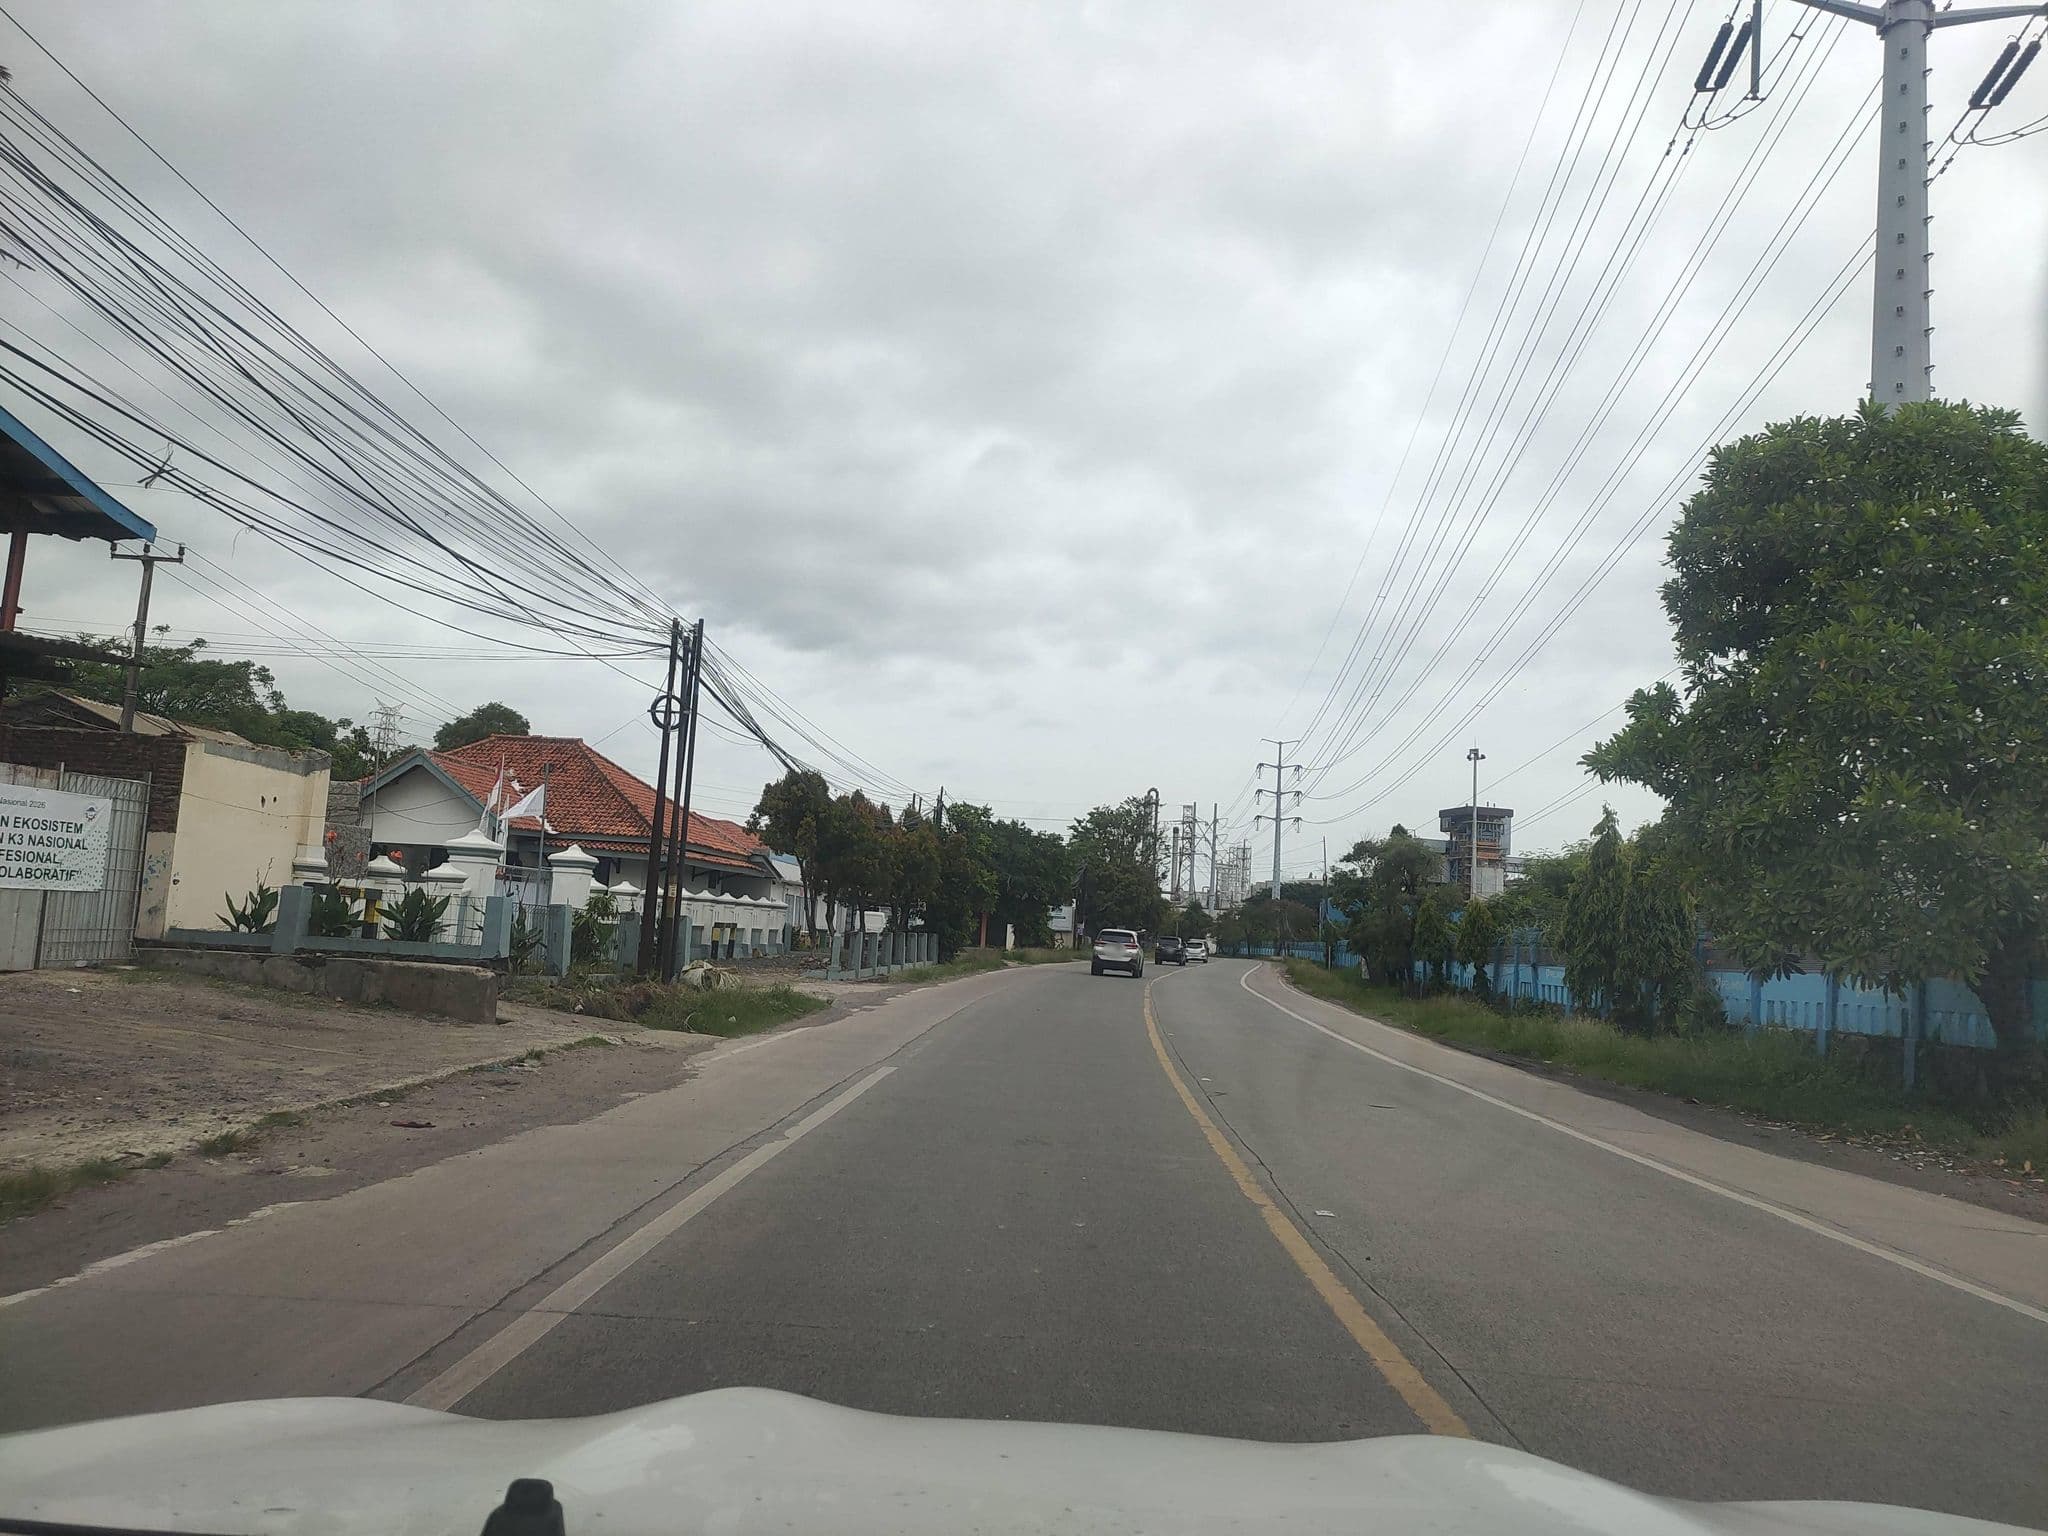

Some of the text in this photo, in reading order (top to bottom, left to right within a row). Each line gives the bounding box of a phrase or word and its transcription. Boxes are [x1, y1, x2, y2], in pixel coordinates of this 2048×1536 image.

[13, 816, 83, 834] EKOSISTEM
[8, 832, 24, 846] K3
[27, 834, 88, 850] NASIONAL
